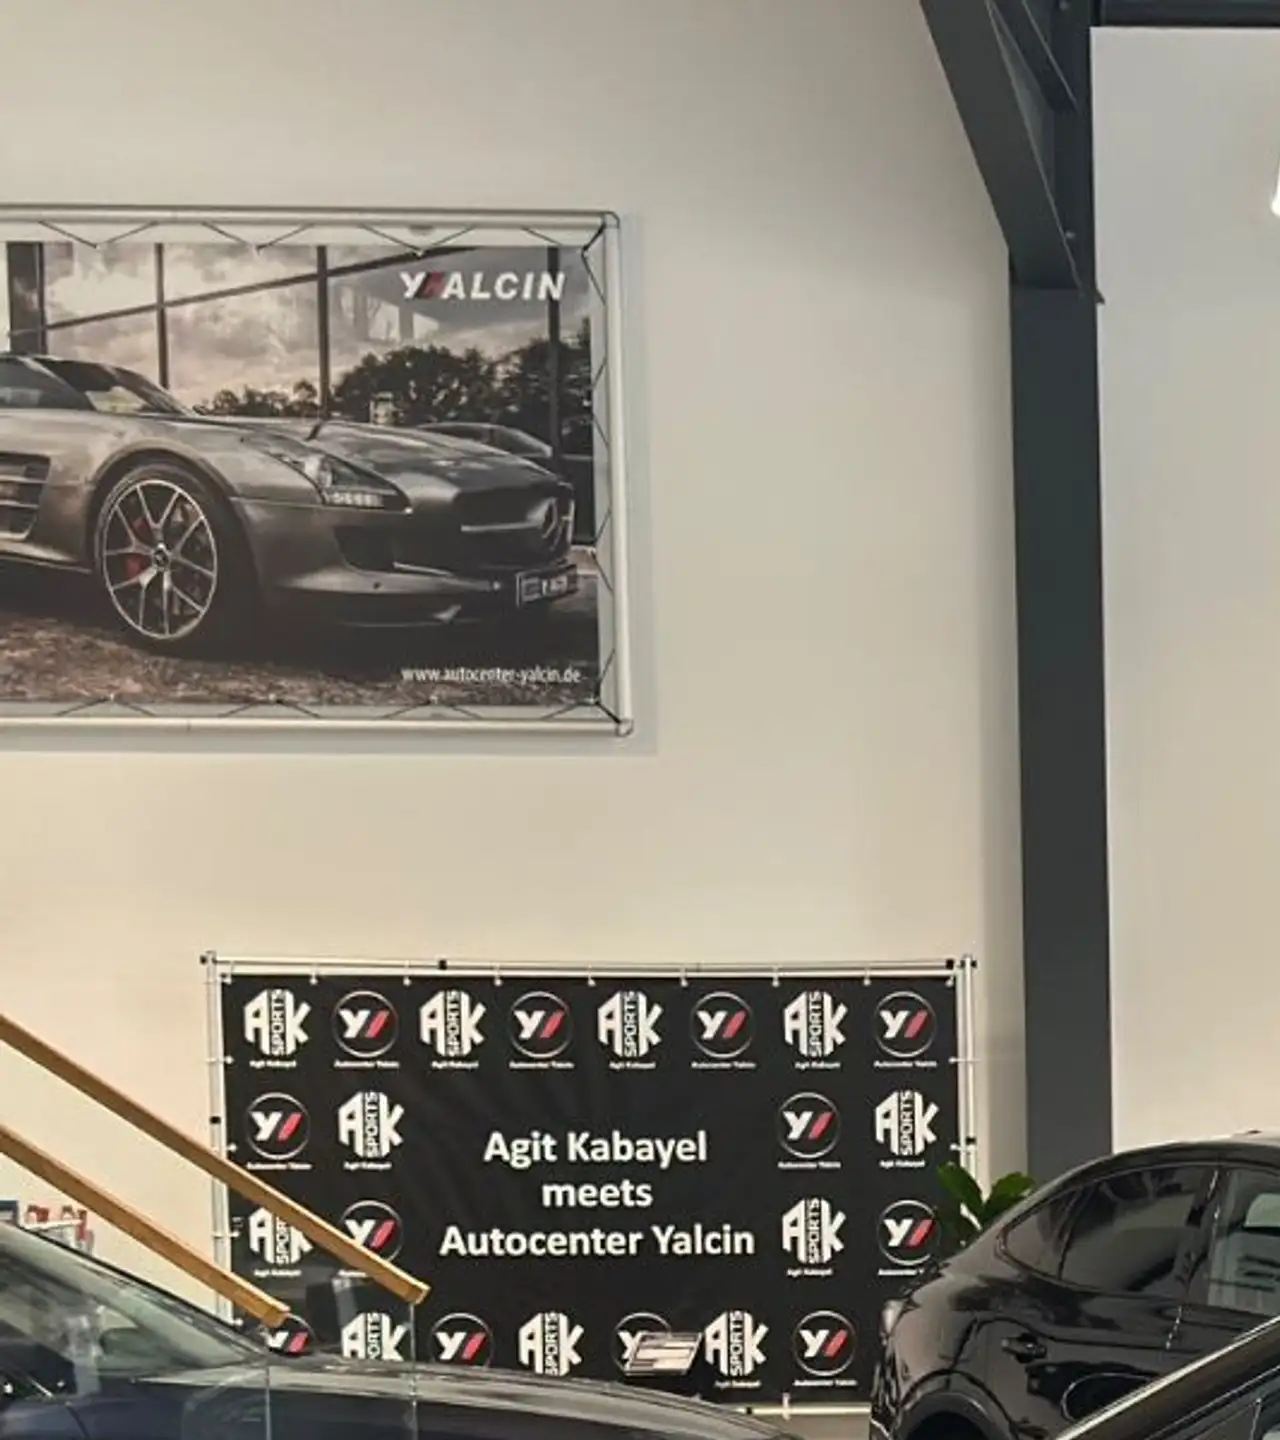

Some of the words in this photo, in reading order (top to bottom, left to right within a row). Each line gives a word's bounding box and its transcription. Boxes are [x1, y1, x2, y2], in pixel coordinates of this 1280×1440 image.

[484, 1130, 557, 1169] Agit
[567, 1130, 708, 1169] Kabayel
[542, 1179, 653, 1207] meets
[439, 1224, 644, 1257] Autocenter
[651, 1223, 755, 1256] Yalcin
